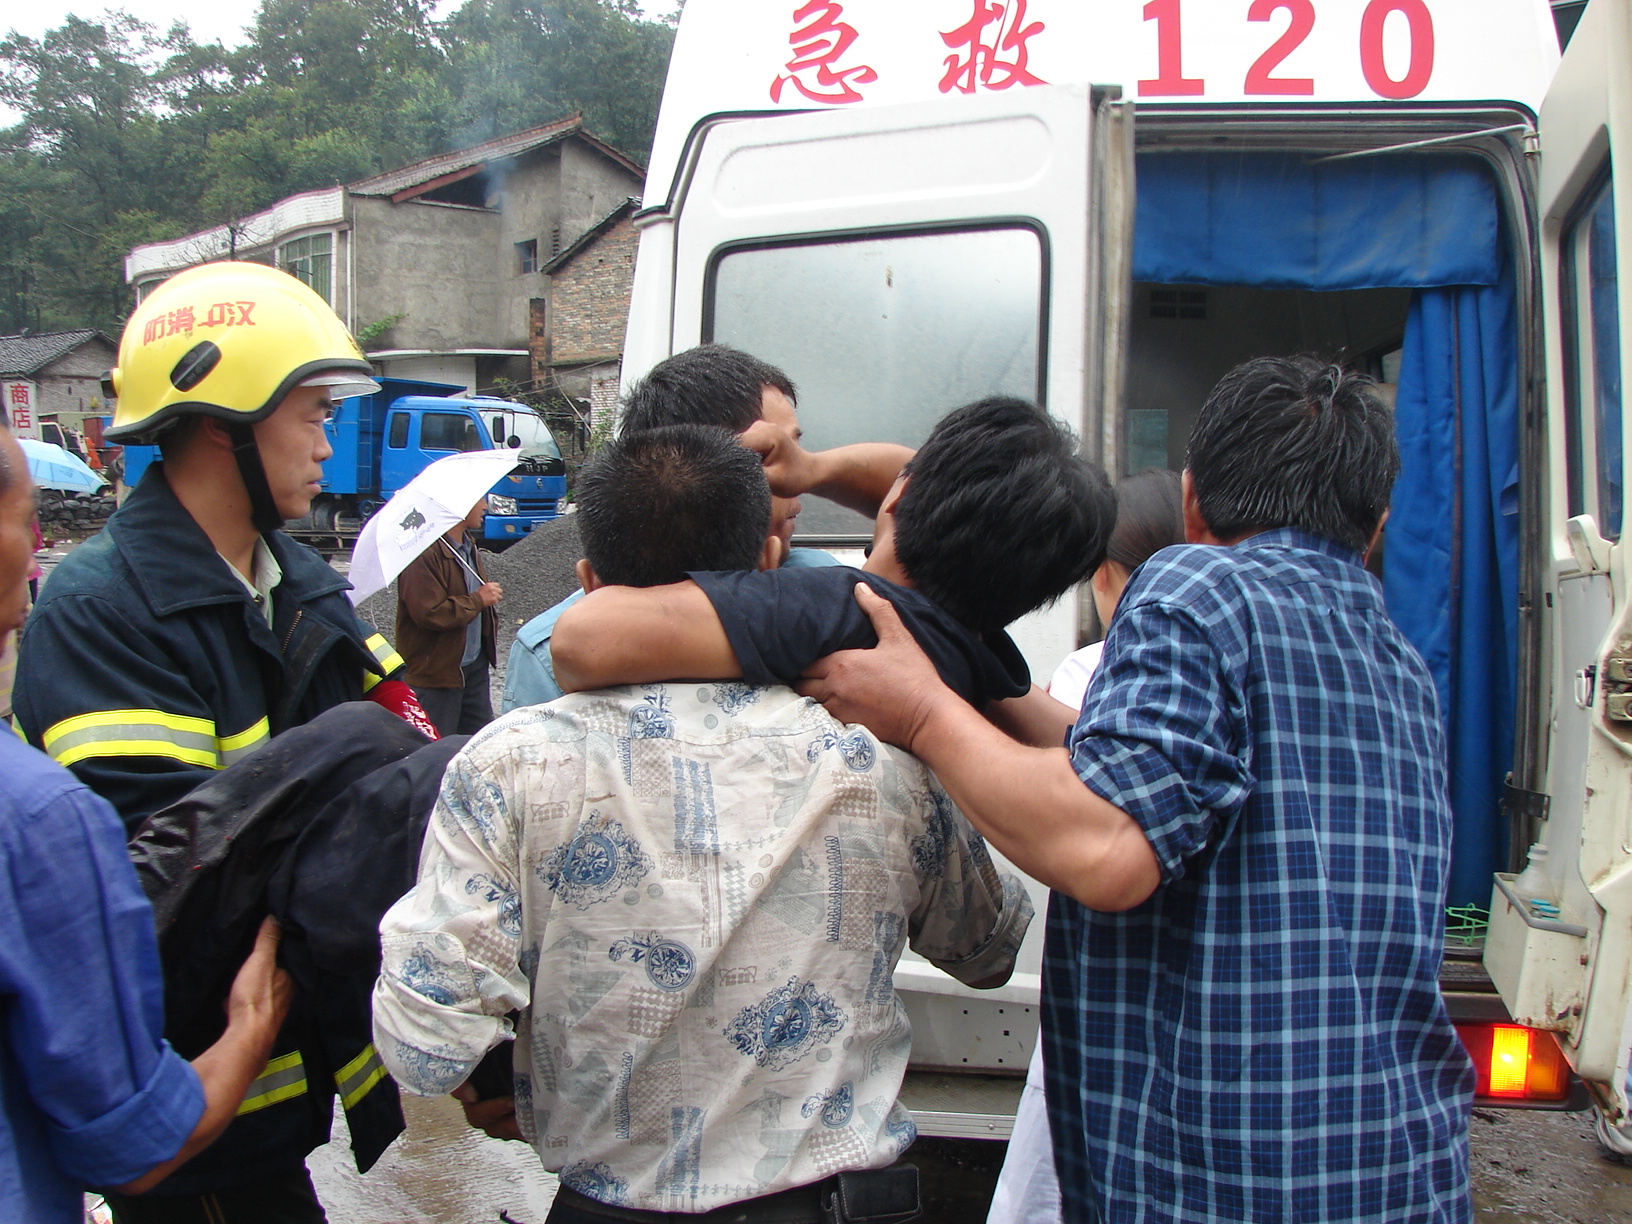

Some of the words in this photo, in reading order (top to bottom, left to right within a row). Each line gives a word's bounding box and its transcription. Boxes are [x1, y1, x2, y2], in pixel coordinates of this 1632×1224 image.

[769, 0, 1053, 104] 急救
[1137, 0, 1435, 100] 120
[9, 382, 32, 430] 商店
